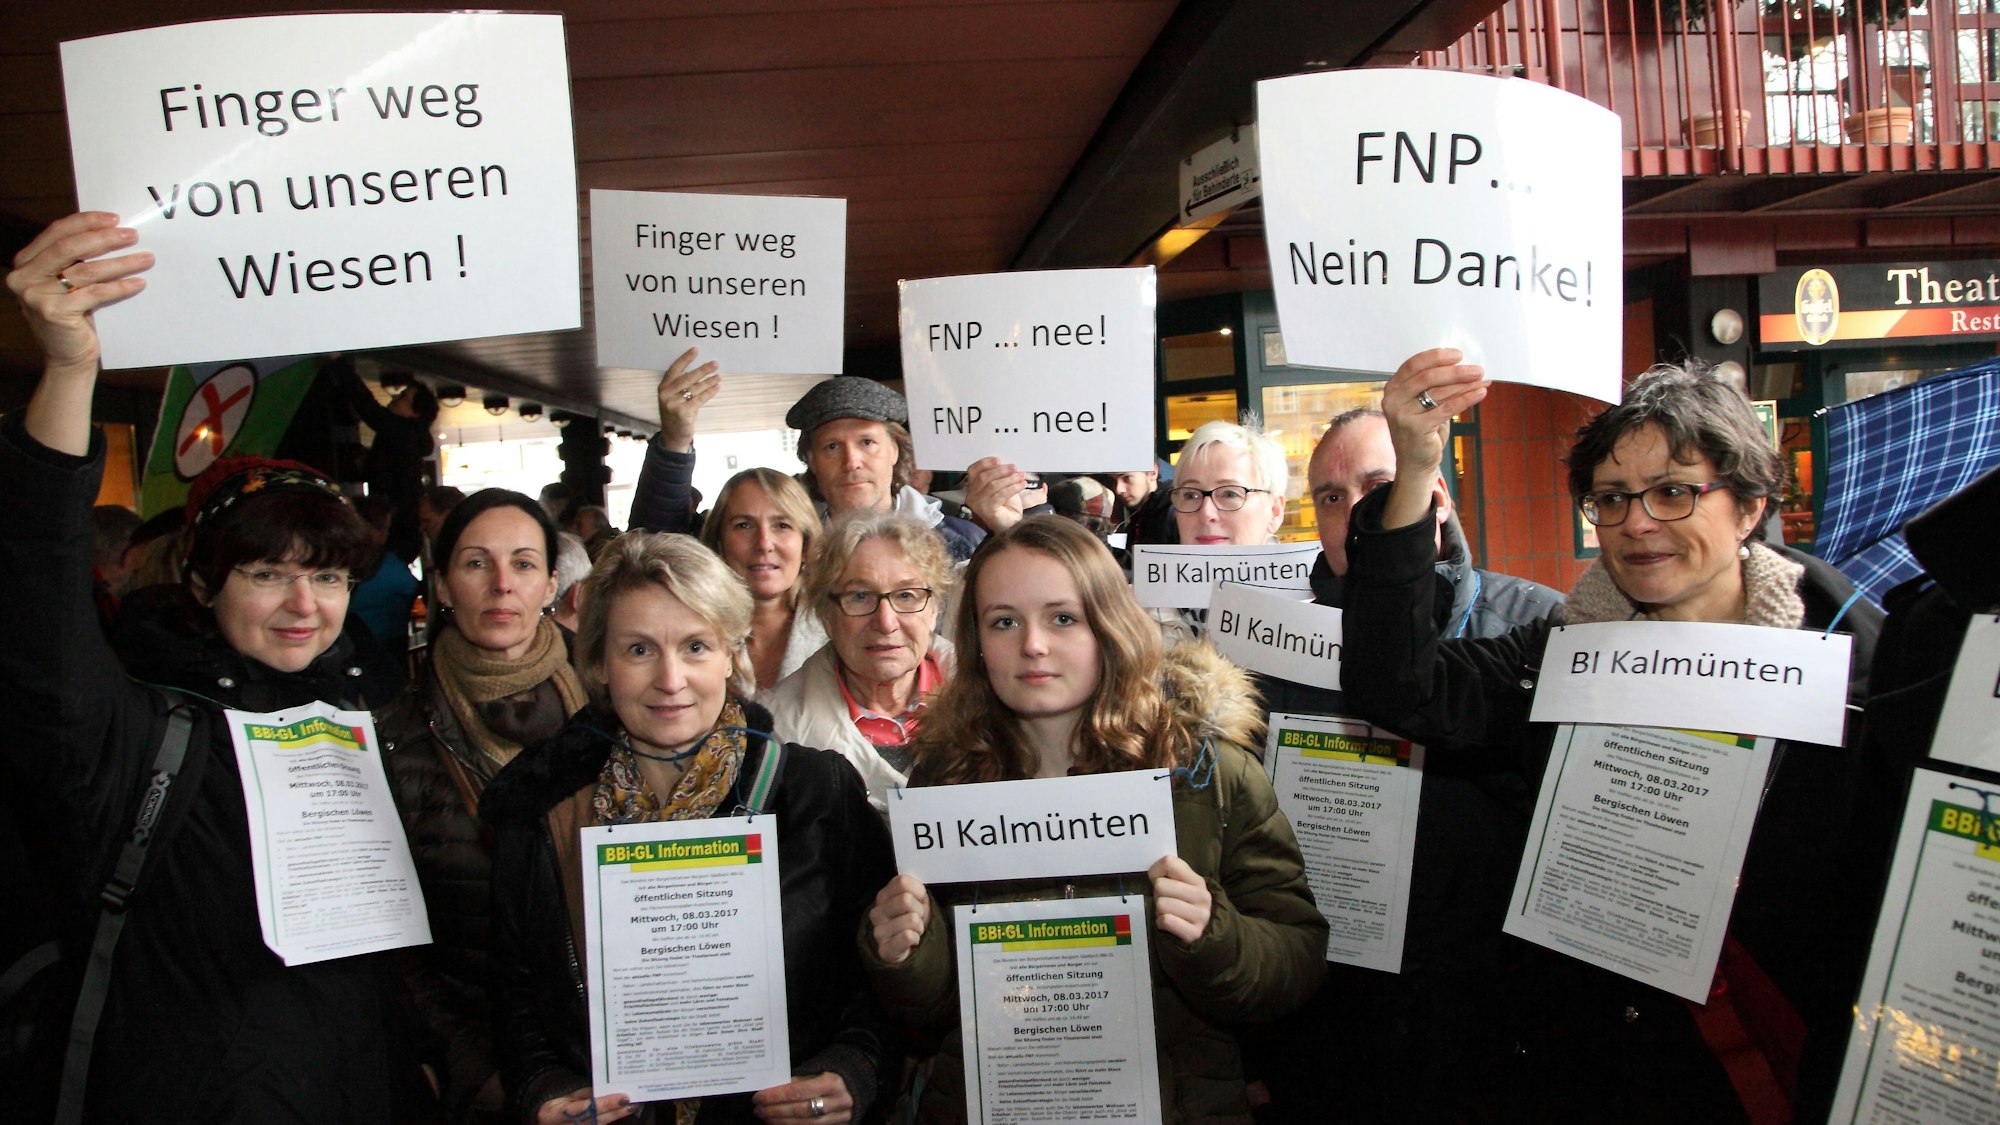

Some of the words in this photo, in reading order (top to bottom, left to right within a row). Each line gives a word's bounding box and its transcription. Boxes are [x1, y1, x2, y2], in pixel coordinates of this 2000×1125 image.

[159, 83, 347, 136] Finger
[367, 84, 482, 128] weg
[147, 179, 263, 219] von
[286, 165, 507, 210] unseren
[637, 224, 725, 256] Finger
[735, 234, 796, 258] weg
[217, 251, 432, 299] Wiesen
[457, 235, 466, 278] !
[1290, 239, 1388, 285] Nein
[1413, 238, 1591, 307] Danke!
[625, 274, 676, 293] von
[688, 277, 805, 296] unseren
[1887, 266, 2000, 306] Theat
[652, 313, 758, 338] Wiesen
[774, 315, 778, 338] !
[1951, 310, 2000, 332] Rest
[929, 322, 982, 351] FNP
[1033, 315, 1105, 346] nee!
[934, 406, 982, 434] FNP
[1034, 402, 1106, 432] nee!
[1148, 563, 1166, 583] BI
[1176, 561, 1309, 583] Kalmünten
[1220, 610, 1240, 636] BI
[1571, 651, 1599, 674] BI
[1610, 650, 1802, 685] Kalmünten
[1284, 732, 1320, 748] BBi-GL
[1604, 740, 1665, 762] öffentlichen
[1668, 756, 1710, 774] Sitzung
[1298, 776, 1346, 788] öffentlichen
[1348, 781, 1380, 792] Sitzung
[1594, 760, 1642, 780] Mittwoch,
[1646, 774, 1709, 797] 08.03.2017
[1294, 792, 1332, 804] Mittwoch,
[1334, 798, 1382, 810] 08.03.2017
[1610, 778, 1626, 788] um
[1630, 782, 1660, 796] 17:00
[1664, 790, 1684, 802] Uhr
[1323, 806, 1346, 815] 17:00
[1348, 808, 1364, 818] Uhr
[1594, 794, 1651, 817] Bergischen
[1654, 811, 1690, 828] Löwen
[914, 822, 944, 850] BI
[957, 812, 1148, 847] Kalmünten
[1297, 820, 1342, 833] Bergischen
[1344, 826, 1370, 837] Löwen
[605, 844, 654, 863] BBi-GL
[658, 840, 740, 859] Information
[634, 891, 694, 904] öffentlichen
[696, 888, 734, 900] Sitzung
[630, 912, 680, 924] Mittwoch,
[682, 908, 739, 921] 08.03.2017
[670, 923, 698, 932] 17:00
[701, 921, 720, 930] Uhr
[978, 924, 1025, 941] BBi-GL
[1028, 920, 1108, 938] Information
[640, 946, 696, 956] Bergischen
[699, 940, 732, 951] Löwen
[1006, 972, 1064, 982] öffentlichen
[1066, 970, 1104, 980] Sitzung
[1004, 994, 1050, 1004] Mittwoch,
[1054, 991, 1109, 1001] 08.03.2017
[1042, 1004, 1070, 1012] 17:00
[1072, 1002, 1090, 1011] Uhr
[1014, 1026, 1068, 1036] Bergischen
[1070, 1024, 1102, 1032] Löwen
